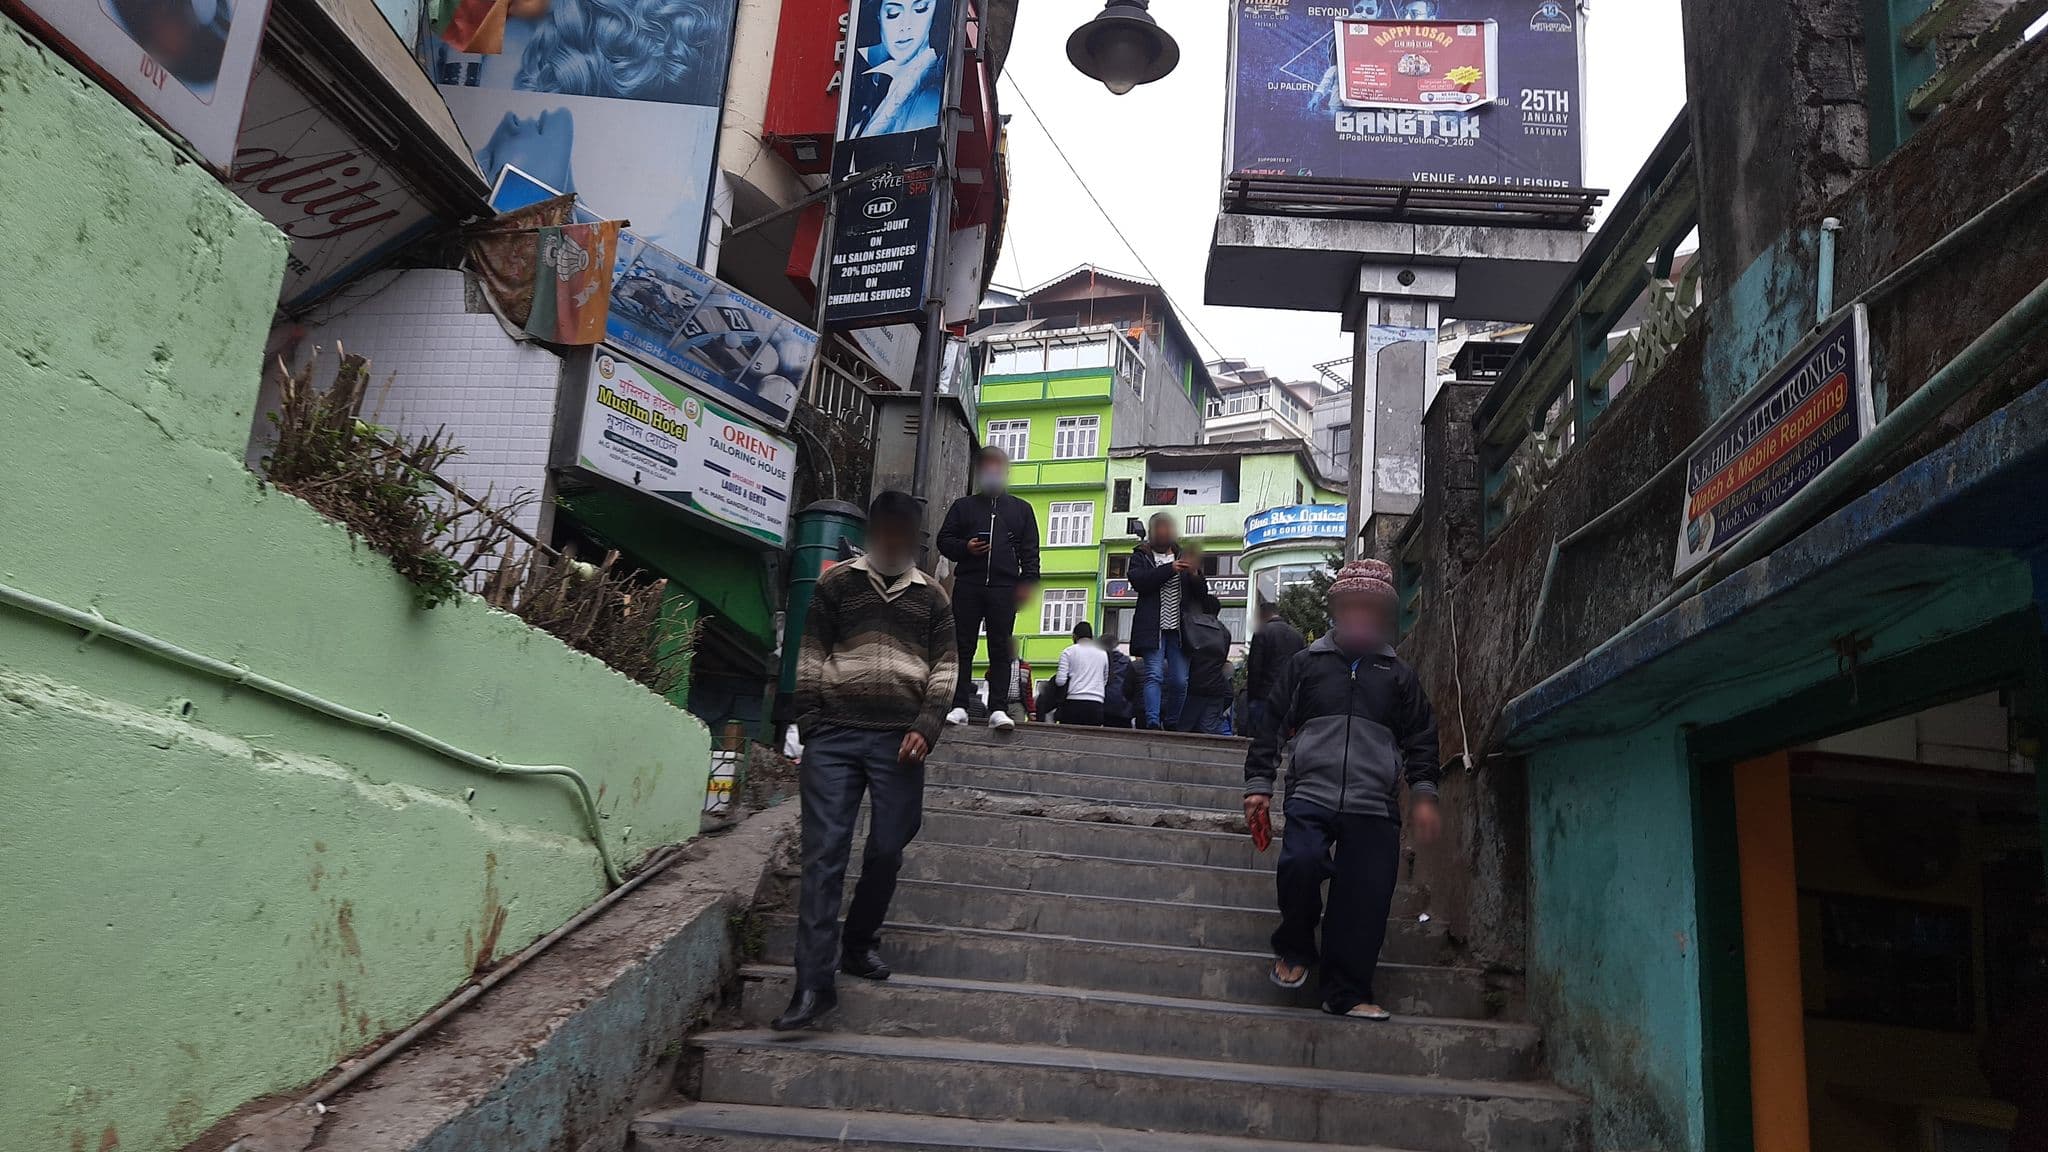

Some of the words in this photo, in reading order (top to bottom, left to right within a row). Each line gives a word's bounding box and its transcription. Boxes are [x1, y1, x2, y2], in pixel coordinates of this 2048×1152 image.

[1308, 7, 1349, 17] BEYOND
[1374, 25, 1411, 47] HAPPY
[1415, 26, 1454, 48] LOSAR
[140, 55, 168, 91] IDLY
[1268, 82, 1278, 91] DJ
[1280, 82, 1314, 91] PALDEN
[1521, 88, 1569, 113] 25TH
[1335, 111, 1480, 139] GANGTOK
[1522, 112, 1568, 124] JANUARY
[1524, 127, 1568, 137] SATURDAY
[871, 178, 902, 191] STYLE
[1412, 172, 1456, 184] VENUE
[868, 202, 893, 214] FLAT
[870, 236, 882, 247] ON
[833, 254, 847, 265] ALL
[848, 250, 875, 264] SALON
[876, 244, 916, 260] SERVICES
[677, 262, 710, 285] DERBY
[841, 266, 860, 278] 20%
[861, 260, 904, 275] DISCOUNT
[865, 277, 878, 288] ON
[828, 291, 869, 306] CHEMICAL
[870, 287, 912, 301] SERVICES
[728, 293, 773, 320] ROULETTE
[622, 330, 668, 360] SUMBHA
[669, 355, 710, 382] ONLINE
[754, 362, 763, 371] 5
[1747, 335, 1847, 440] ELECTRONICS
[785, 393, 792, 403] 7
[597, 384, 650, 425] Muslim
[651, 410, 688, 442] Hotel
[722, 425, 778, 462] ORIENT
[1691, 477, 1724, 515] Watch
[1726, 472, 1735, 490] &
[1738, 438, 1777, 480] Mobile
[1780, 381, 1845, 448] Repairing
[709, 436, 756, 466] TAILORING
[757, 460, 786, 481] HOUSE
[721, 479, 743, 496] LADIES
[748, 491, 767, 507] GENTS
[1271, 511, 1296, 524] Sky
[1280, 525, 1318, 534] CONTACT
[1322, 525, 1345, 533] LENS
[1214, 580, 1246, 591] CHAR
